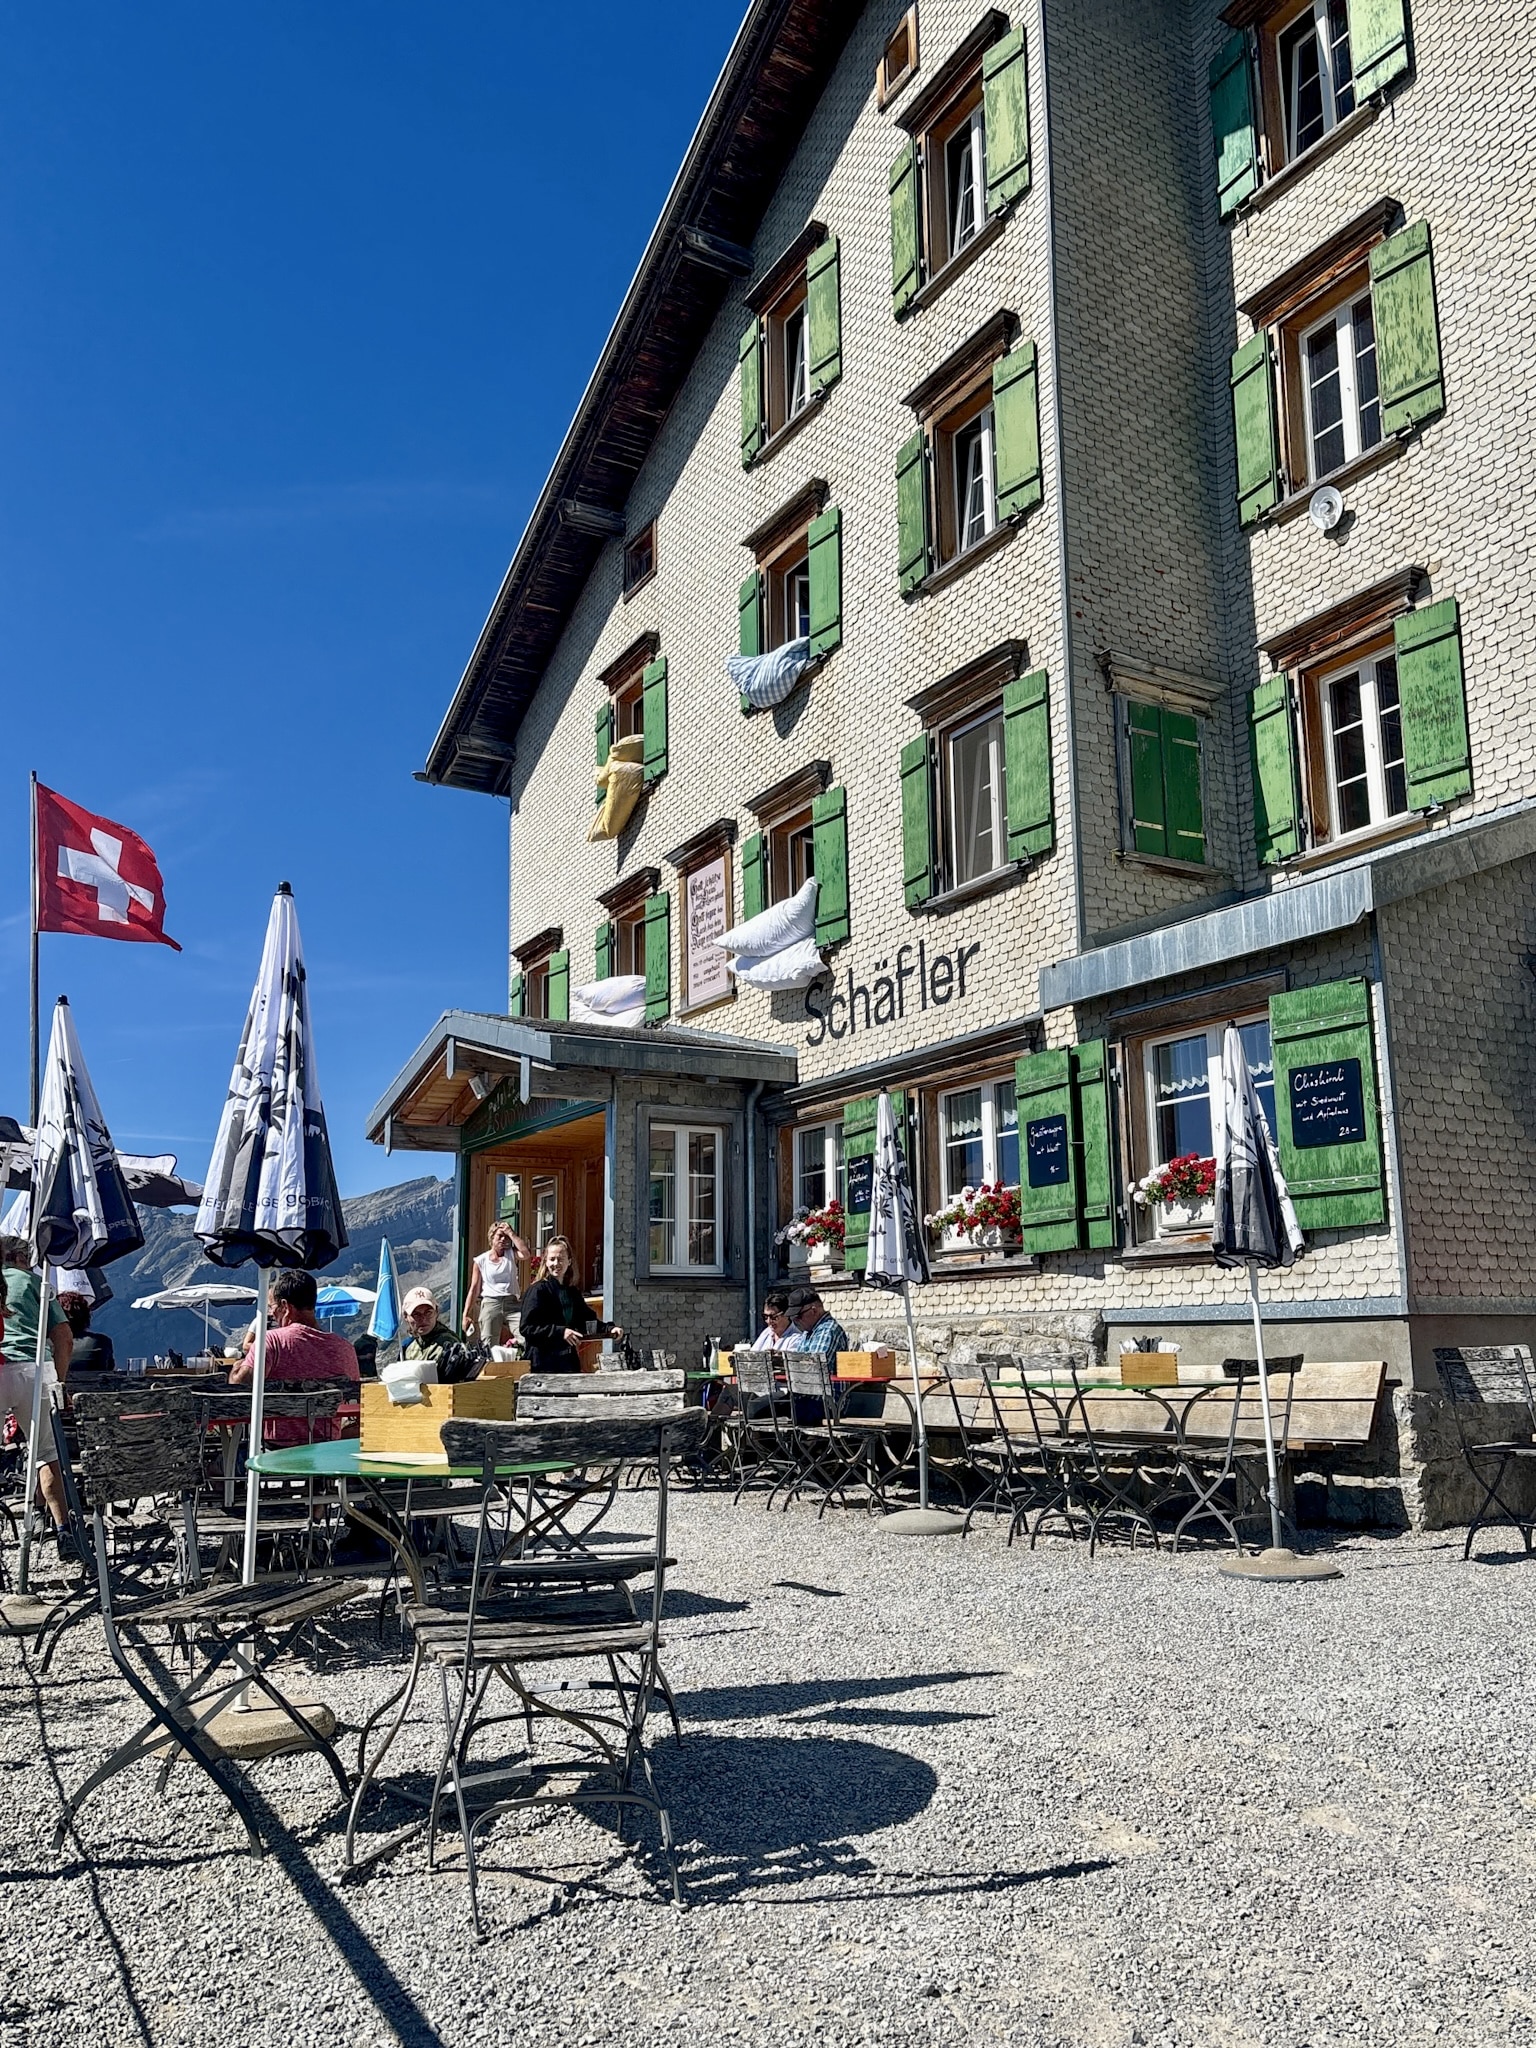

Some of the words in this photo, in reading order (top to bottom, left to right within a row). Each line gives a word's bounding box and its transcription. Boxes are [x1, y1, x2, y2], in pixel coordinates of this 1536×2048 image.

[805, 939, 981, 1046] Schäfler
[1296, 1099, 1308, 1108] mit
[1302, 1113, 1314, 1122] und
